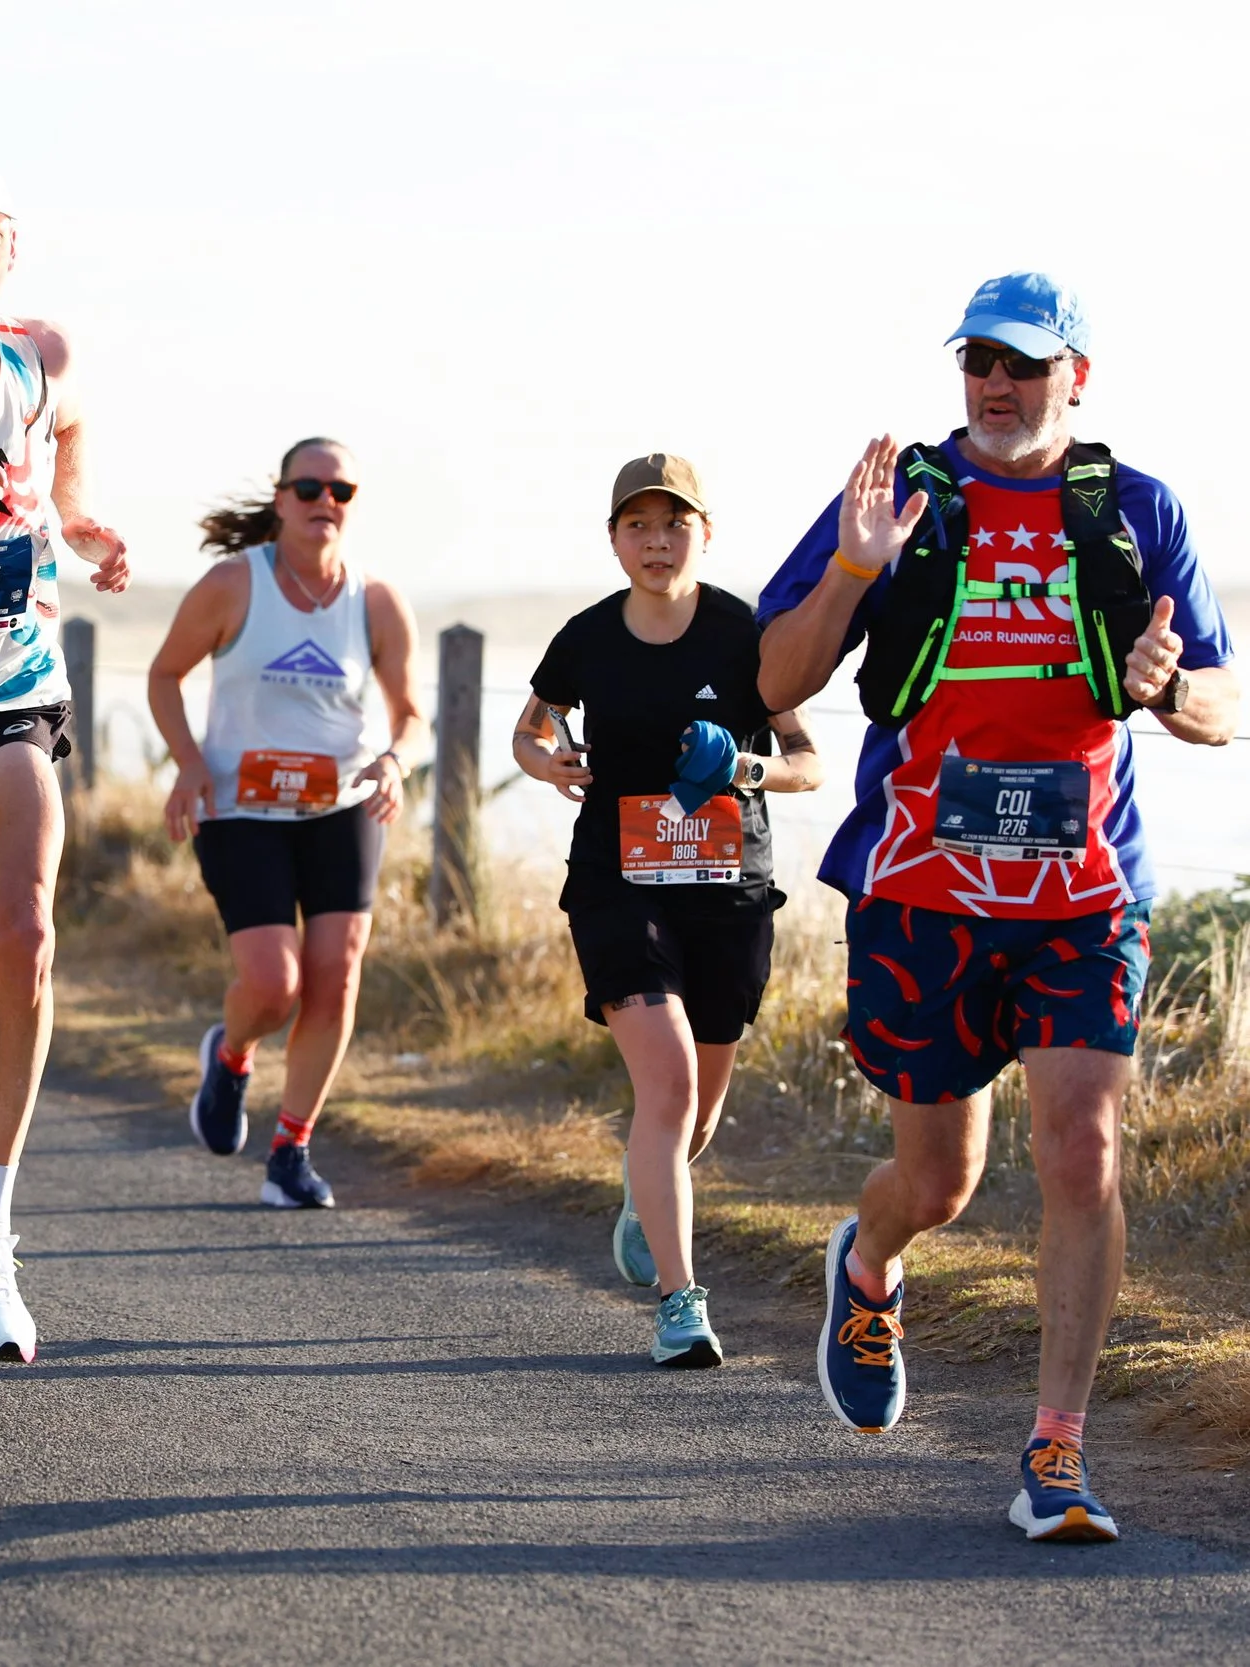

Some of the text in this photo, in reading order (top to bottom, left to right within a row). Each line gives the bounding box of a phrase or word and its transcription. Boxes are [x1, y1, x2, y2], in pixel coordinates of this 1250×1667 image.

[997, 631, 1055, 645] RUNNING
[995, 789, 1032, 816] COL
[656, 818, 711, 843] SHIRLY
[997, 818, 1028, 836] 1276
[671, 844, 698, 860] 1806
